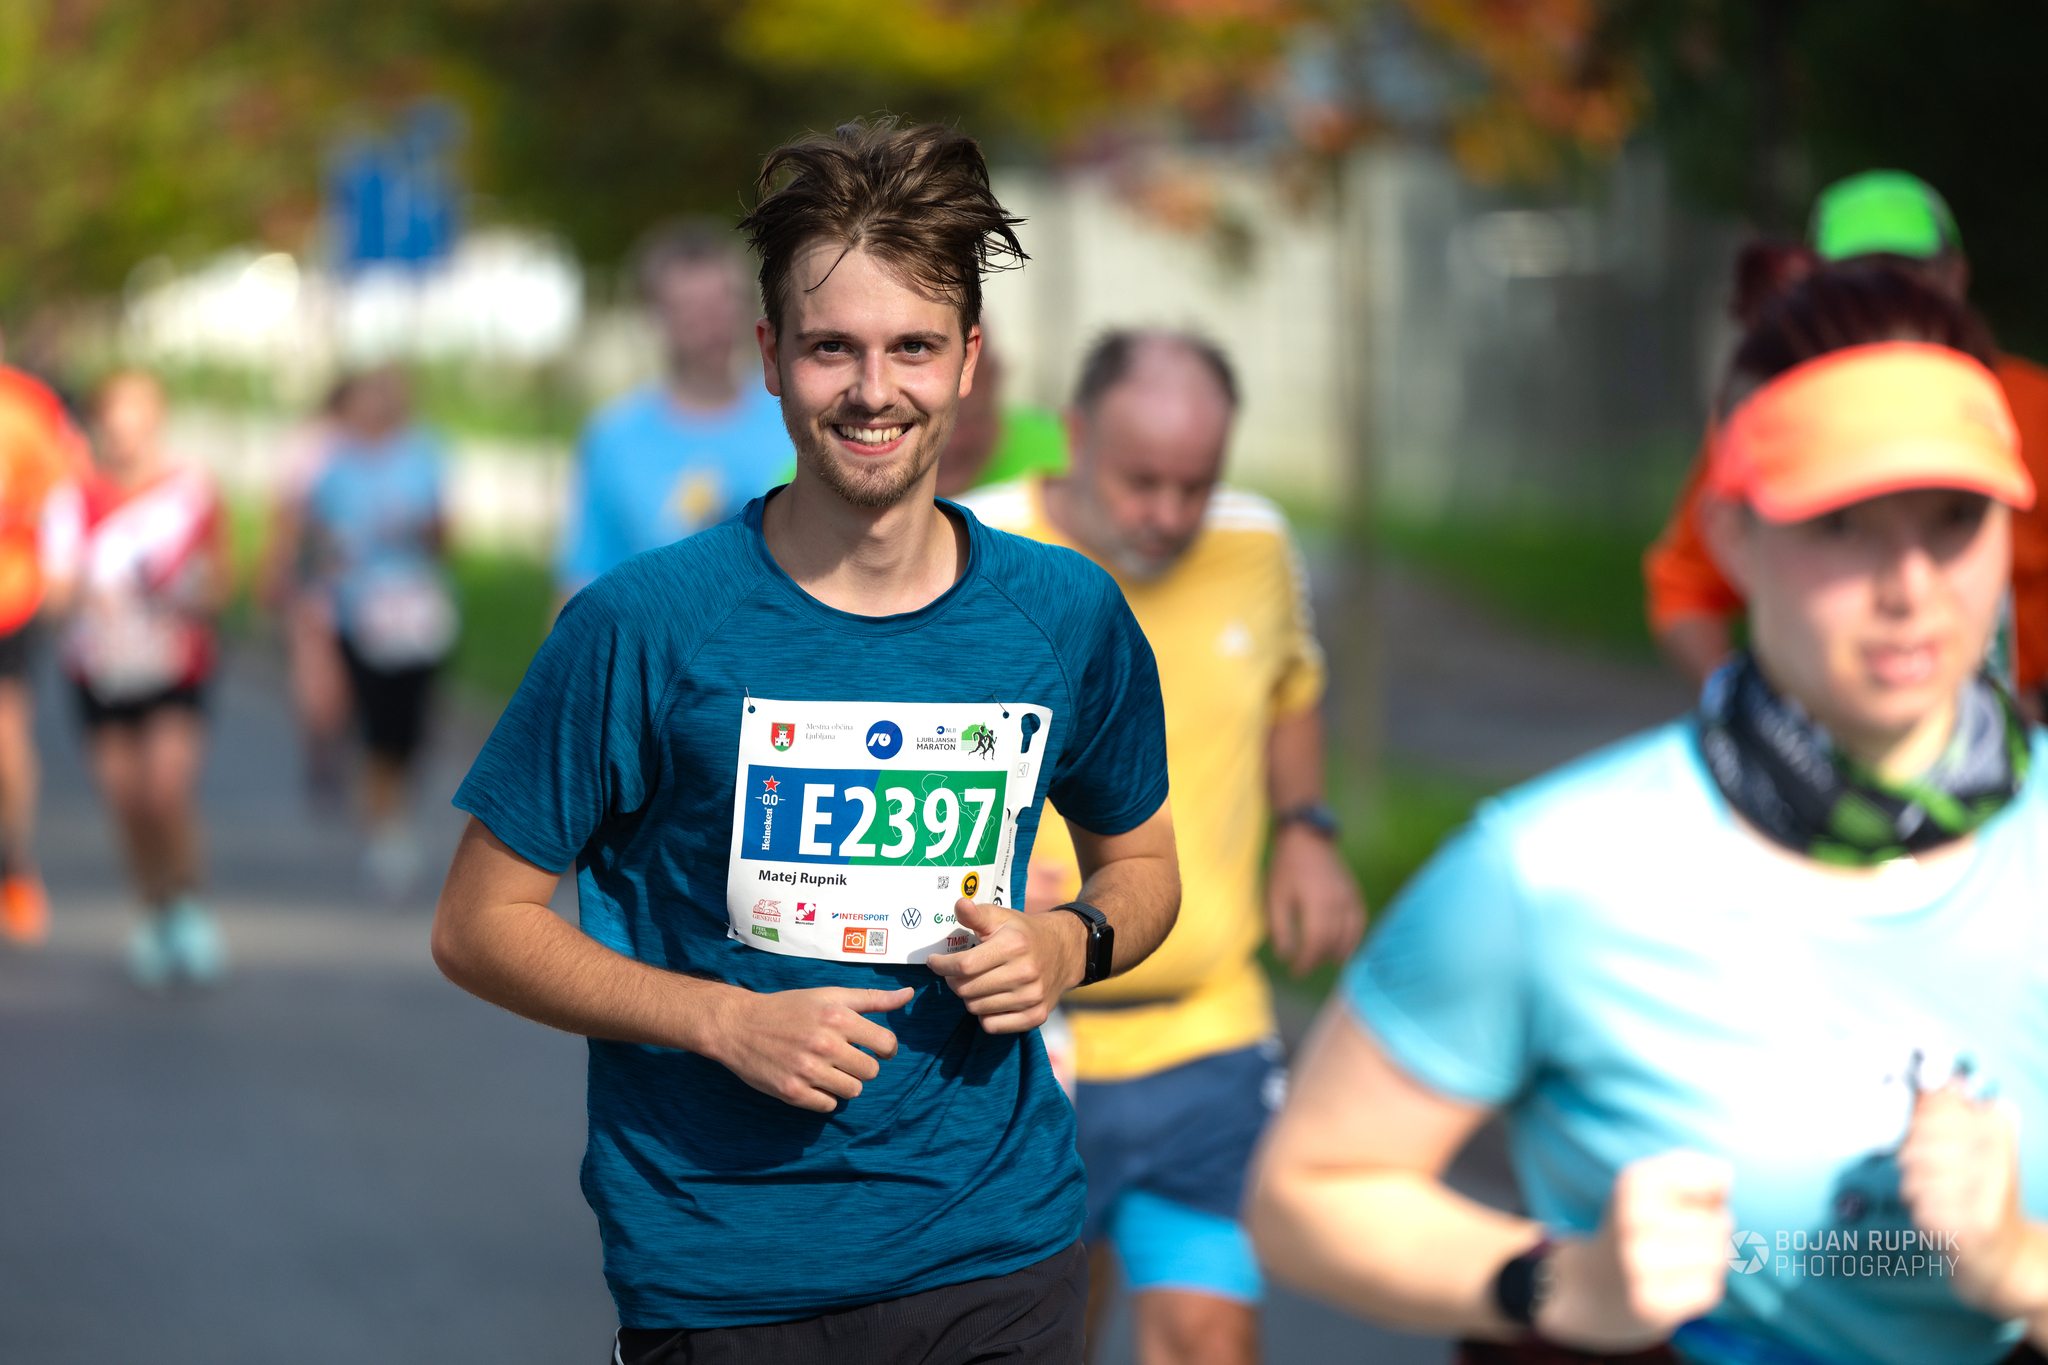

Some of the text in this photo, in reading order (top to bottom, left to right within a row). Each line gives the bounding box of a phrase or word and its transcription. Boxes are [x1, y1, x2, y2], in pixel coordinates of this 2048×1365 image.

[805, 732, 836, 741] Ljubljana
[916, 743, 956, 751] MARATON
[798, 783, 996, 859] E2397
[761, 807, 773, 851] Heineken
[758, 869, 847, 888] Matej Rupnik
[752, 914, 781, 923] GENERALI
[839, 913, 889, 921] INTERSPORT
[946, 934, 970, 947] TIMING
